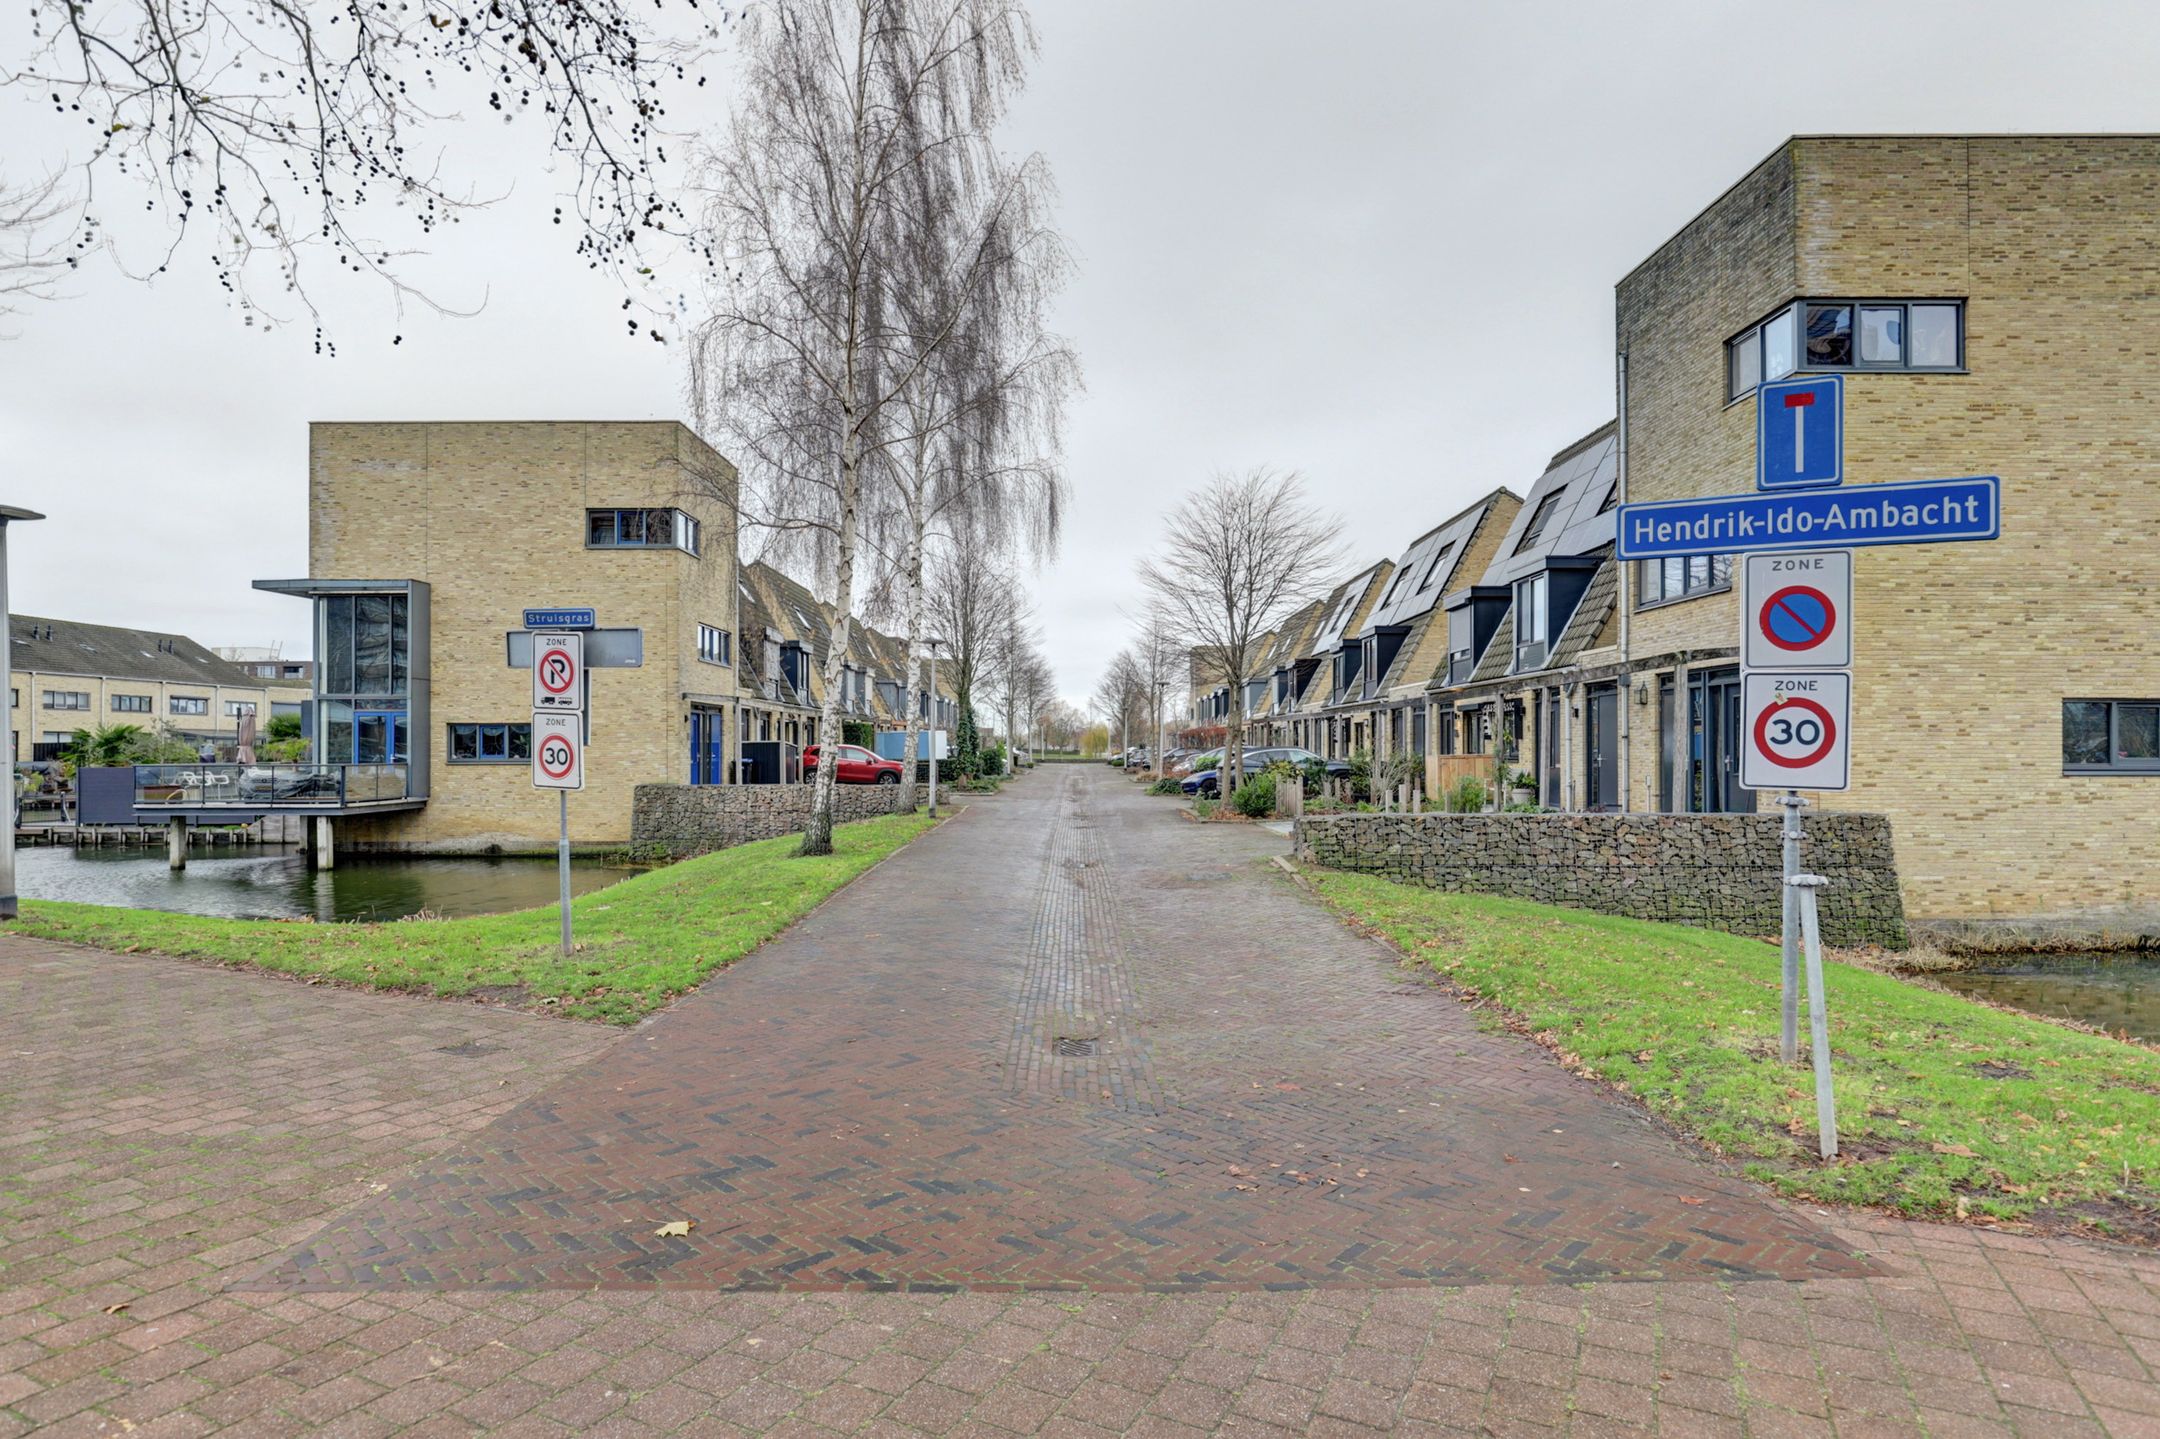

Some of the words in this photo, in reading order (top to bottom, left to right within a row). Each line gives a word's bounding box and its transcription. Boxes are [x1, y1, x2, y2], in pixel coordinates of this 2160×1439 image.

[1634, 495, 1980, 543] Hendrik-Ido-Ambacht
[1771, 558, 1825, 571] ZONE
[529, 614, 590, 625] Struisgras
[546, 638, 567, 646] ZONE
[1774, 680, 1819, 691] ZONE
[1769, 719, 1820, 745] 30
[545, 748, 568, 765] 30
